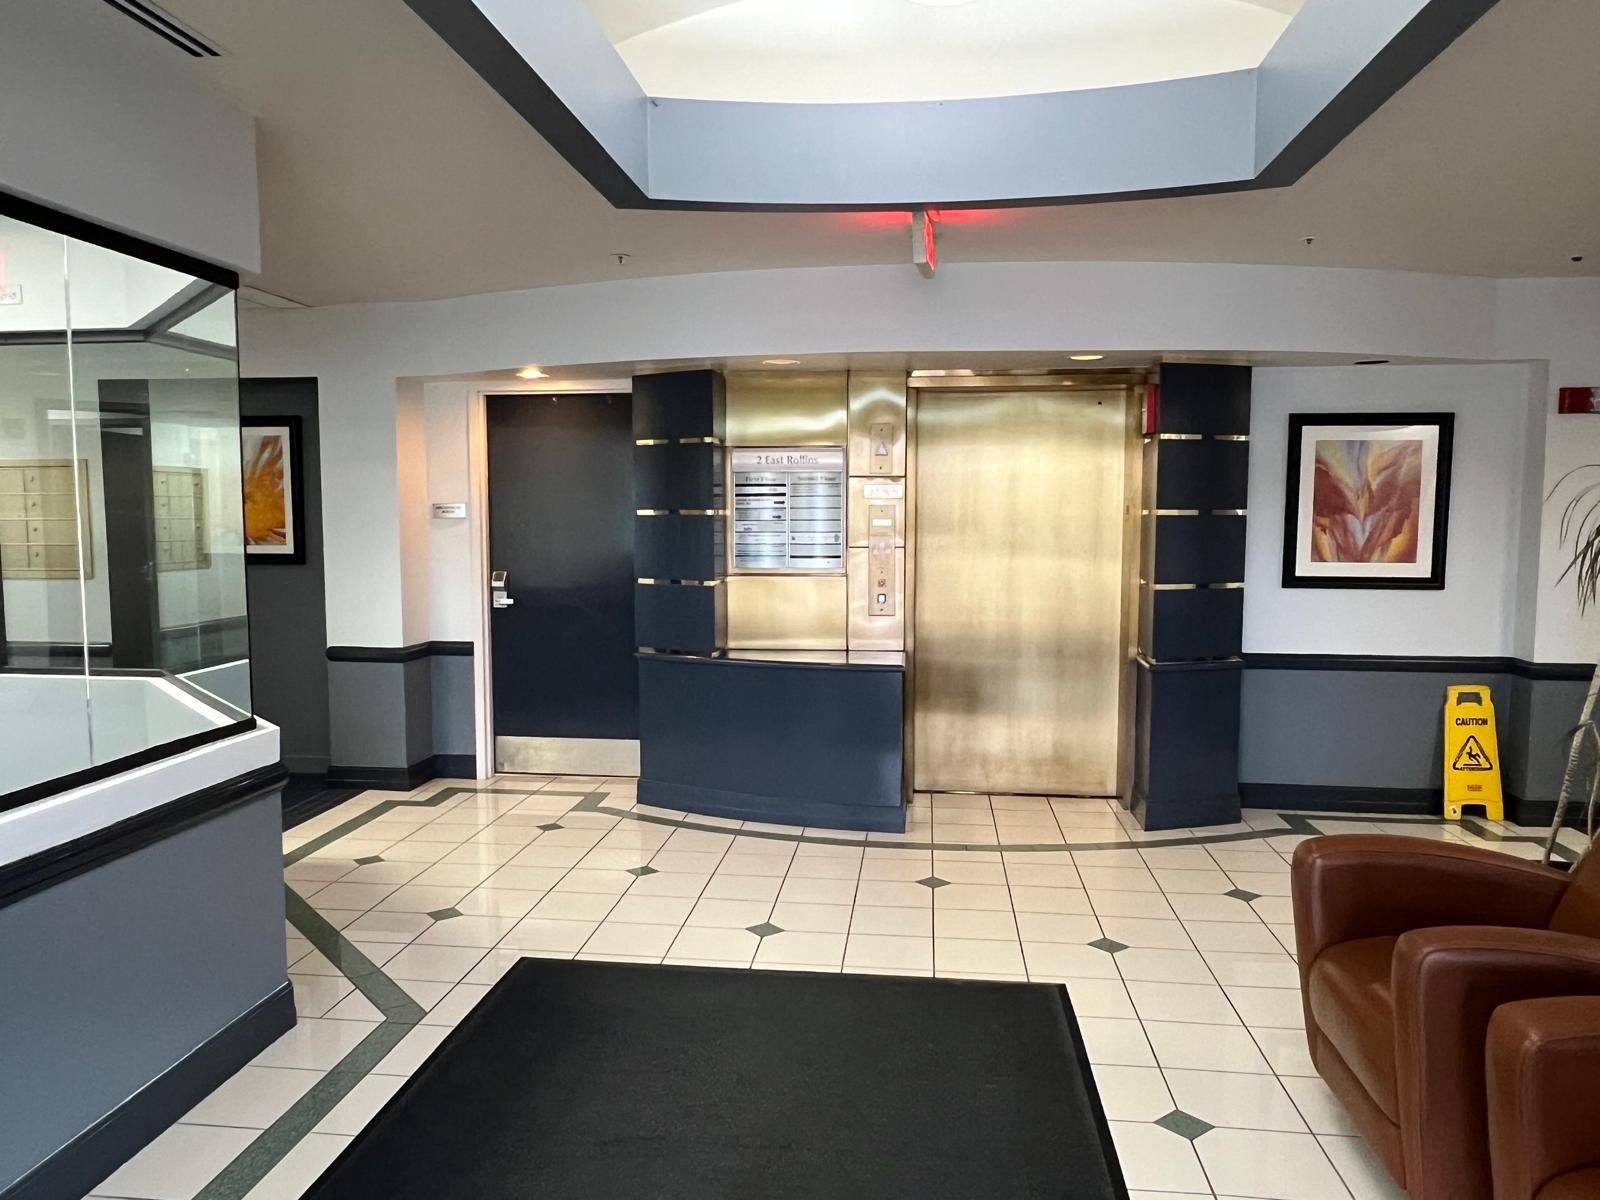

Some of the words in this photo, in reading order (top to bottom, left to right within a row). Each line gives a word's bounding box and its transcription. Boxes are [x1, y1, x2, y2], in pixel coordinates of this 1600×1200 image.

[756, 455, 762, 465] 2
[765, 455, 784, 465] East
[1456, 718, 1488, 726] CAUTION
